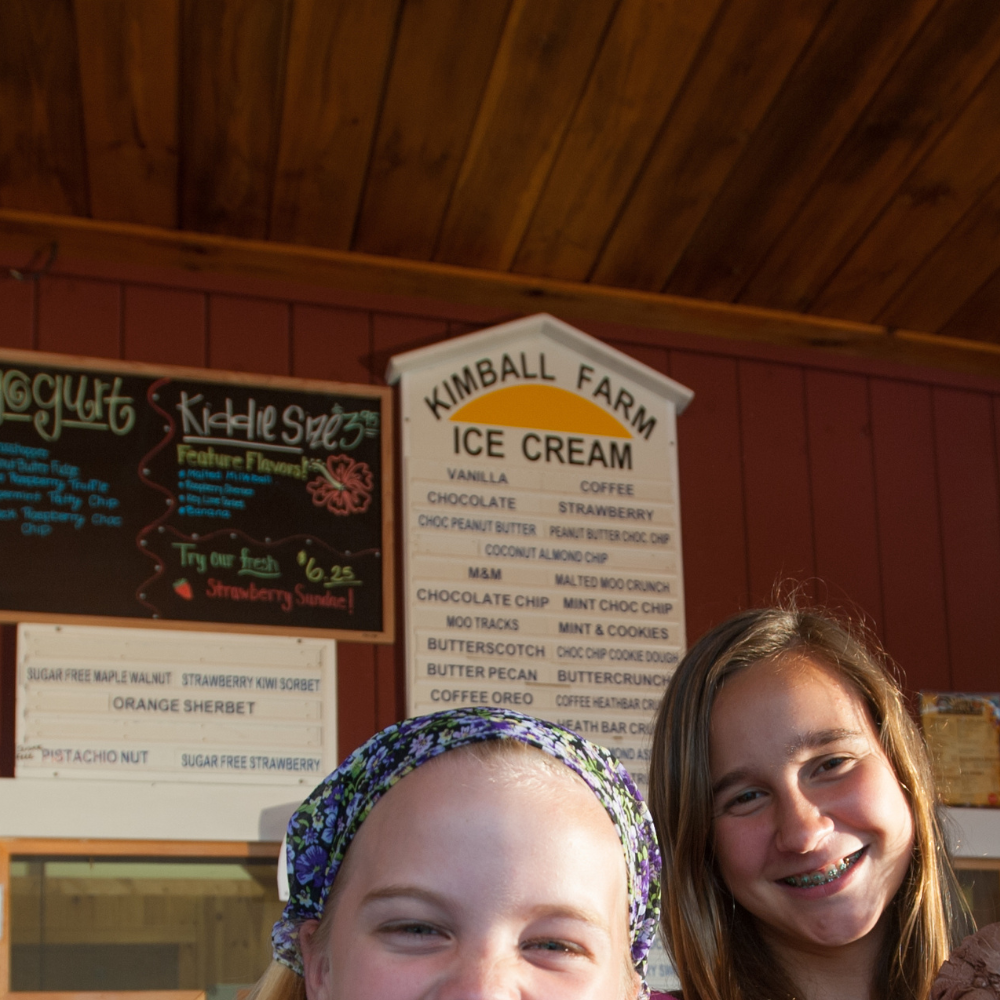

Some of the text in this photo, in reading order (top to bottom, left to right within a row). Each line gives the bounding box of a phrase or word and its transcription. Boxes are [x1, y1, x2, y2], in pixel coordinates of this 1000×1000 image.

[0, 369, 136, 441] ogurt
[424, 352, 658, 441] KIMBALL FARM
[175, 391, 278, 442] Kiddie
[281, 403, 343, 450] Size
[453, 425, 634, 470] ICE CREAM
[176, 443, 244, 472] Feature
[447, 467, 634, 496] VANILLA COFFEE
[427, 491, 654, 521] CHOCOLATE STRAWBERRY
[418, 513, 536, 536] CHOC PEANUT BUTTER
[550, 525, 585, 539] PEANUT
[586, 527, 621, 543] BUTTER
[171, 542, 208, 574] Try
[210, 551, 237, 569] our
[239, 547, 280, 572] fresh
[484, 543, 608, 565] COCONUT ALMOND CHIP
[468, 566, 502, 581] M&M
[554, 573, 670, 593] MALTED MOO CRUNCH
[206, 577, 292, 613] Strawberry
[417, 588, 550, 609] CHOCOLATE CHIP
[563, 597, 673, 615] MINT CHOC CHIP
[446, 615, 519, 632] MOO TRACKS
[558, 622, 669, 640] MINT & COOKIES
[427, 637, 546, 658] BUTTERSCOTCH
[556, 645, 585, 660] CHOC
[587, 646, 607, 660] CHIP
[609, 647, 644, 663] COOKIE
[26, 667, 172, 686] SUGAR FREE MAPLE WALNUT
[427, 663, 538, 682] BUTTER PECAN
[557, 670, 670, 687] BUTTERCRUNCH
[181, 673, 320, 692] STRAWBERRY KIWI SORBET
[112, 696, 256, 715] ORANGE SHERBET
[430, 688, 533, 706] COFFEE OREO
[555, 694, 591, 708] COFFEE
[601, 720, 627, 734] BAR
[41, 749, 117, 765] PISTACHIO
[121, 751, 148, 765] NUT
[181, 753, 321, 772] SUGAR FREE STRAWBERRY
